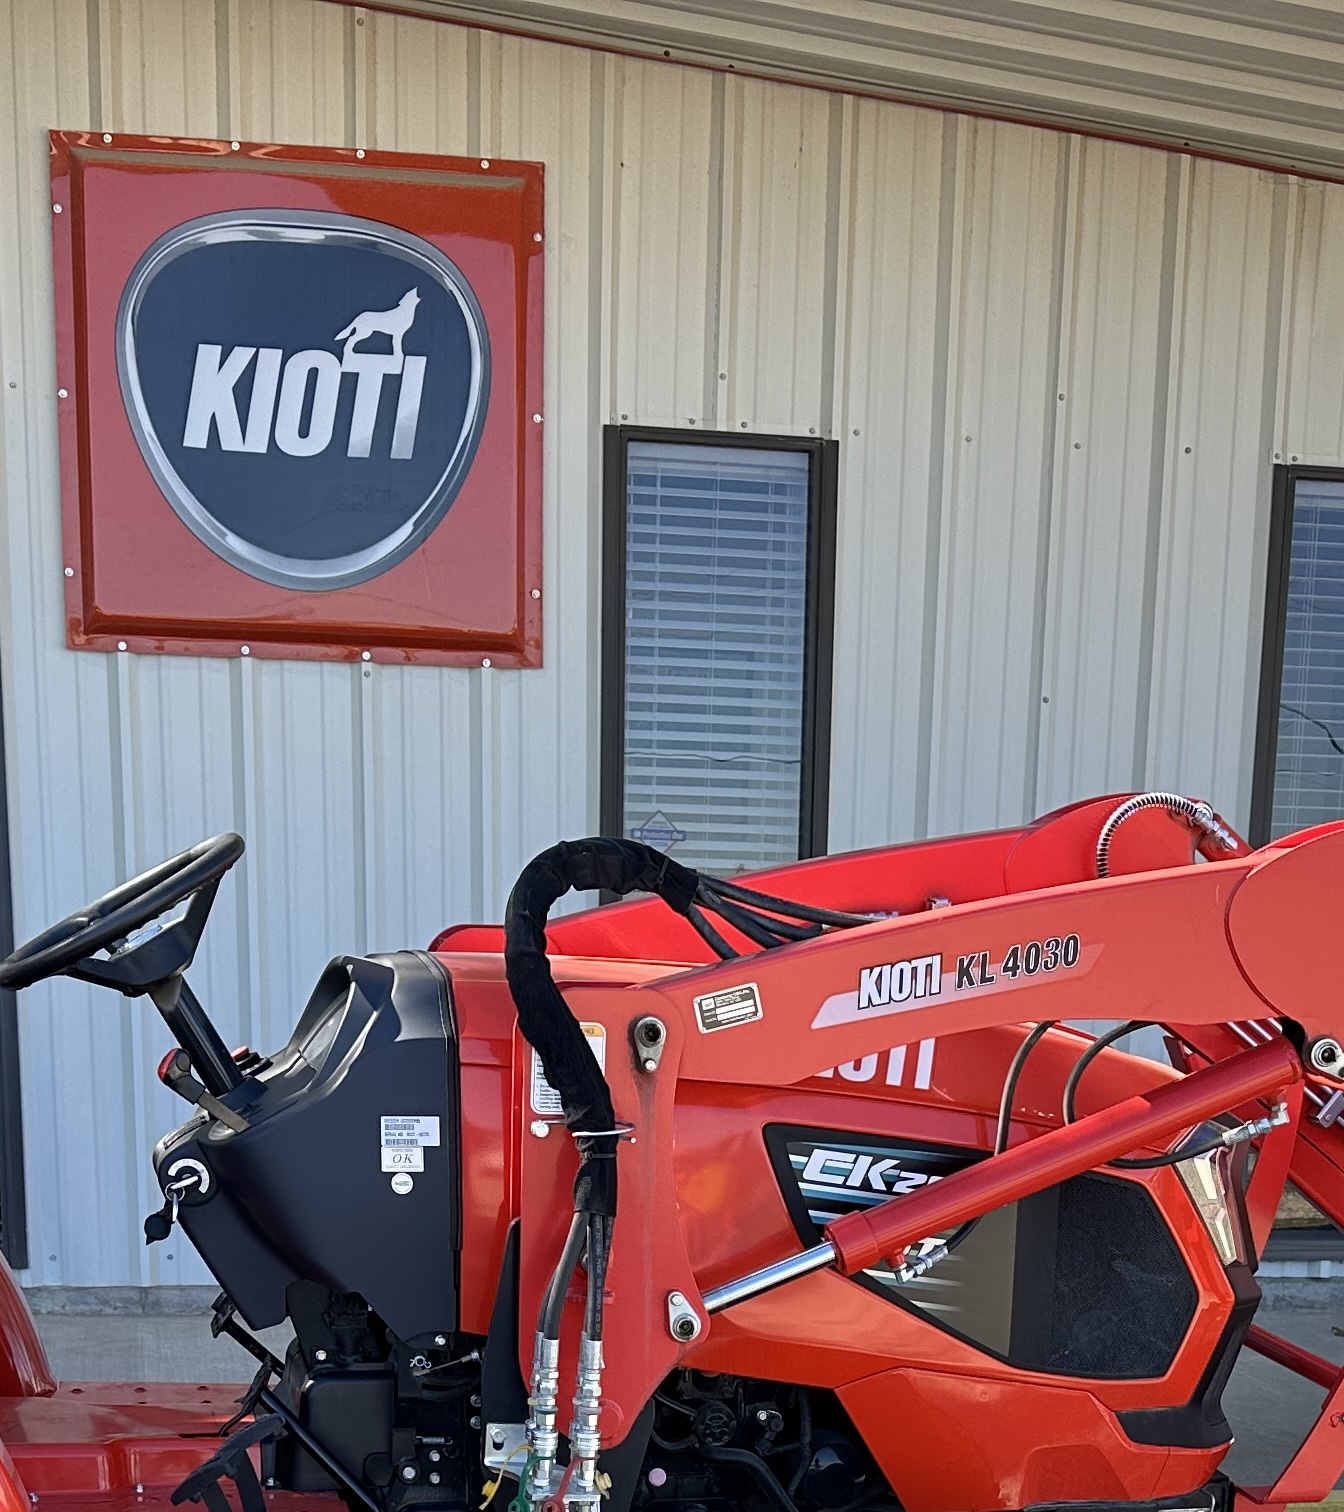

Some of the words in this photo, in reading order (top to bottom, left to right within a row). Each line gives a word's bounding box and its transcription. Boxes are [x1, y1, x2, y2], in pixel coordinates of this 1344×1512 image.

[182, 342, 428, 461] KIOTI
[857, 952, 943, 1010] KIOTI
[955, 950, 997, 991] KL
[1001, 933, 1081, 981] 4030
[392, 1153, 414, 1164] OK
[802, 1148, 946, 1194] CK2
